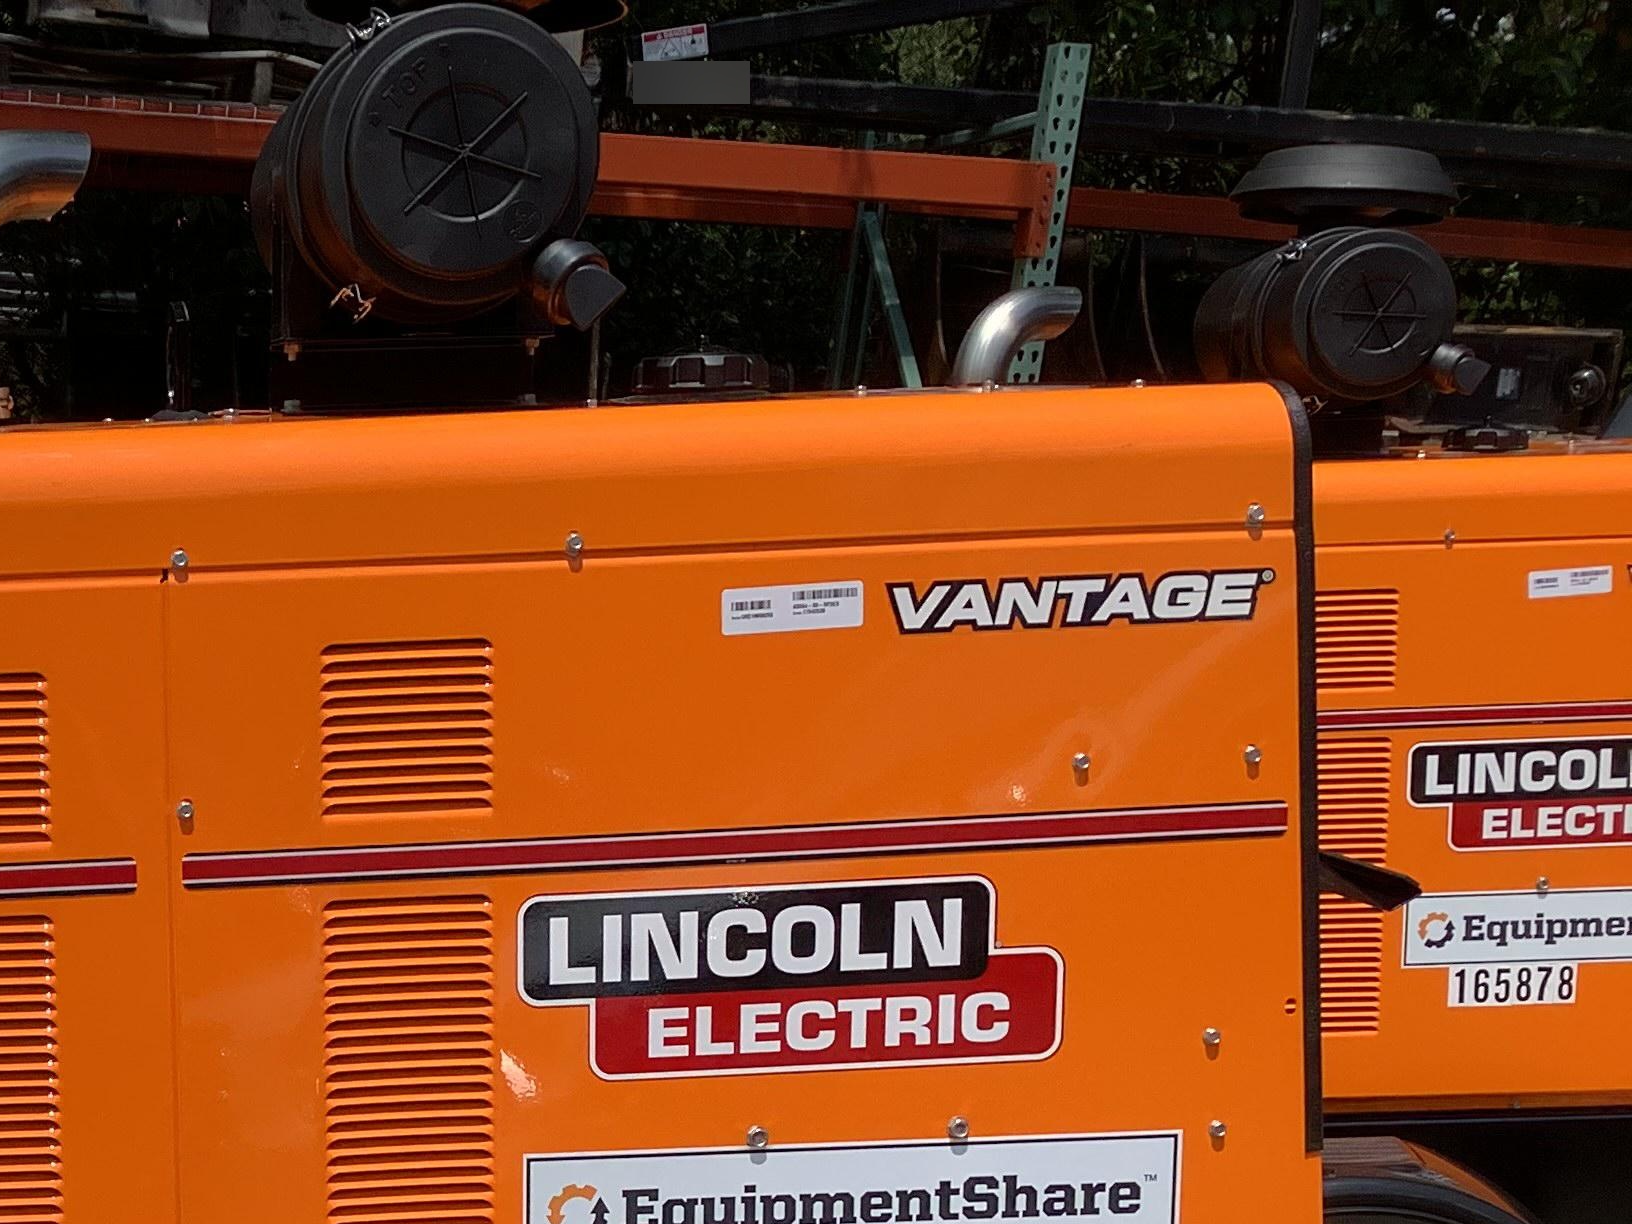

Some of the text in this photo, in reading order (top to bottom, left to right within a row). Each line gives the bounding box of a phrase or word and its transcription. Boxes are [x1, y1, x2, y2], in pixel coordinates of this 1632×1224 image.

[887, 569, 1259, 634] VANTAGE
[1425, 748, 1632, 796] LINCOL
[1482, 804, 1632, 840] ELECT
[548, 897, 964, 986] LINCOLN
[1462, 912, 1632, 947] Equipme
[1454, 965, 1575, 1004] 165878
[647, 991, 1011, 1059] ELECTRIC
